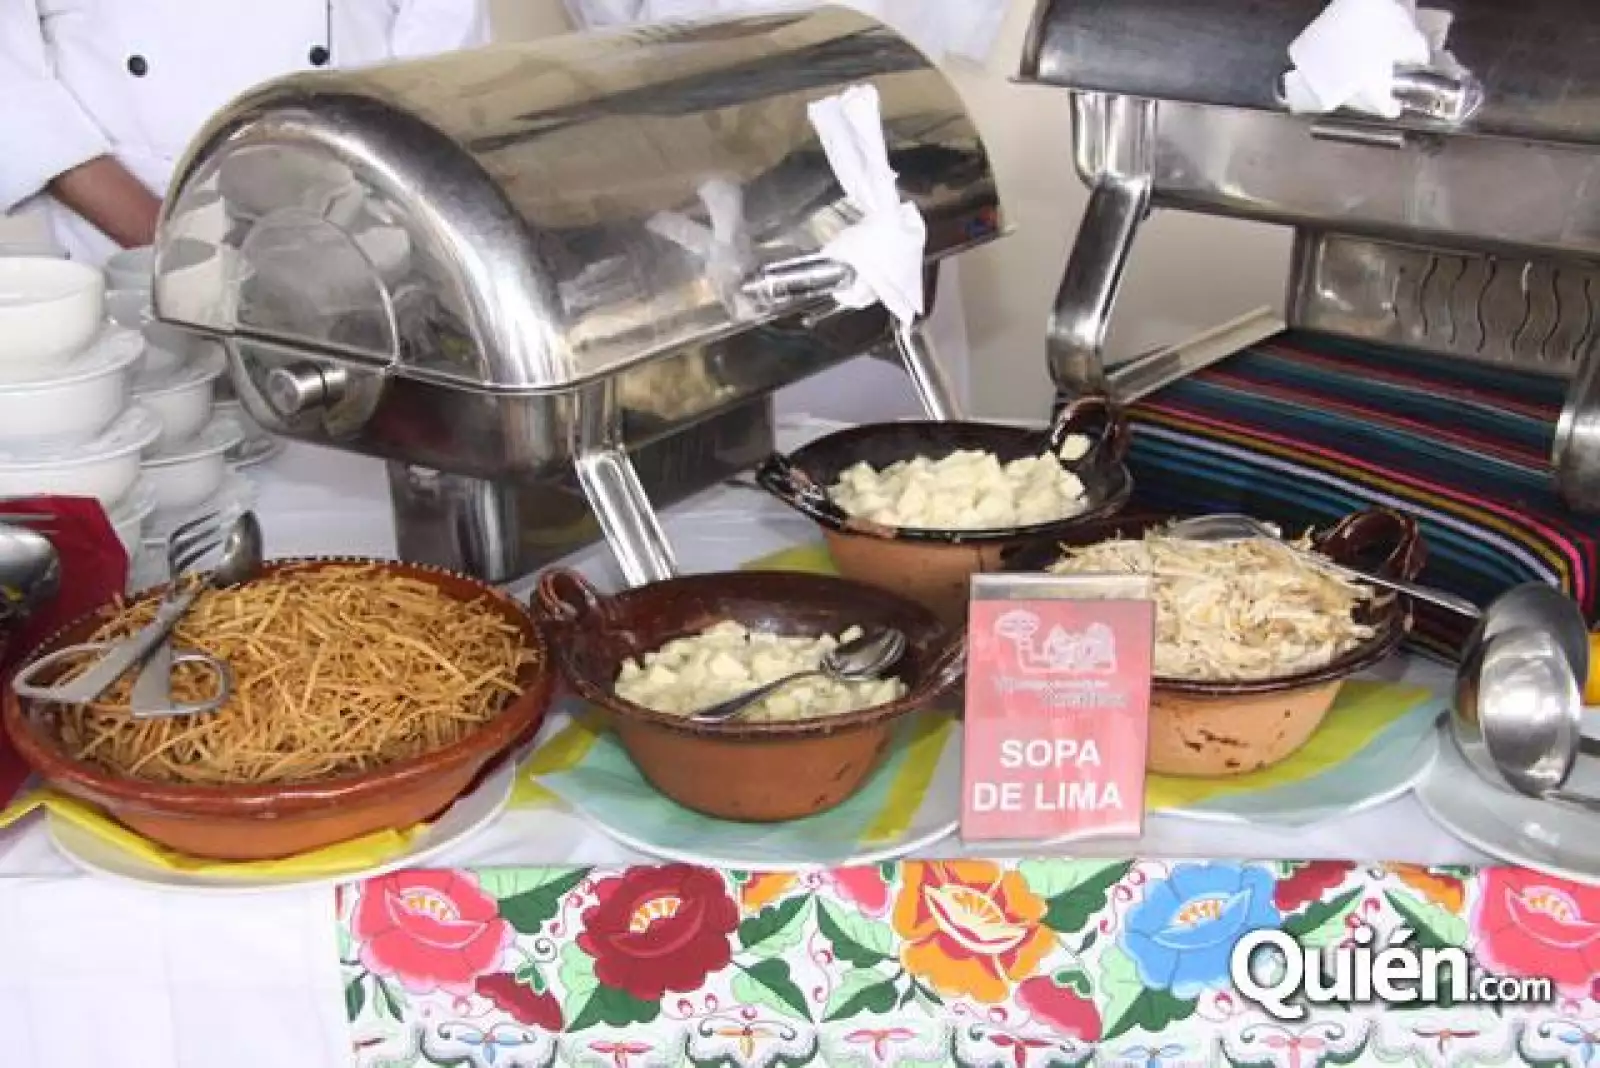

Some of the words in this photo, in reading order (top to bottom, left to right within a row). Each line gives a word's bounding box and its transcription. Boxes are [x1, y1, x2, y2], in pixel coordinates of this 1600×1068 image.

[999, 739, 1101, 769] SOPA
[973, 782, 1024, 812] DE
[1034, 781, 1124, 811] LIMA
